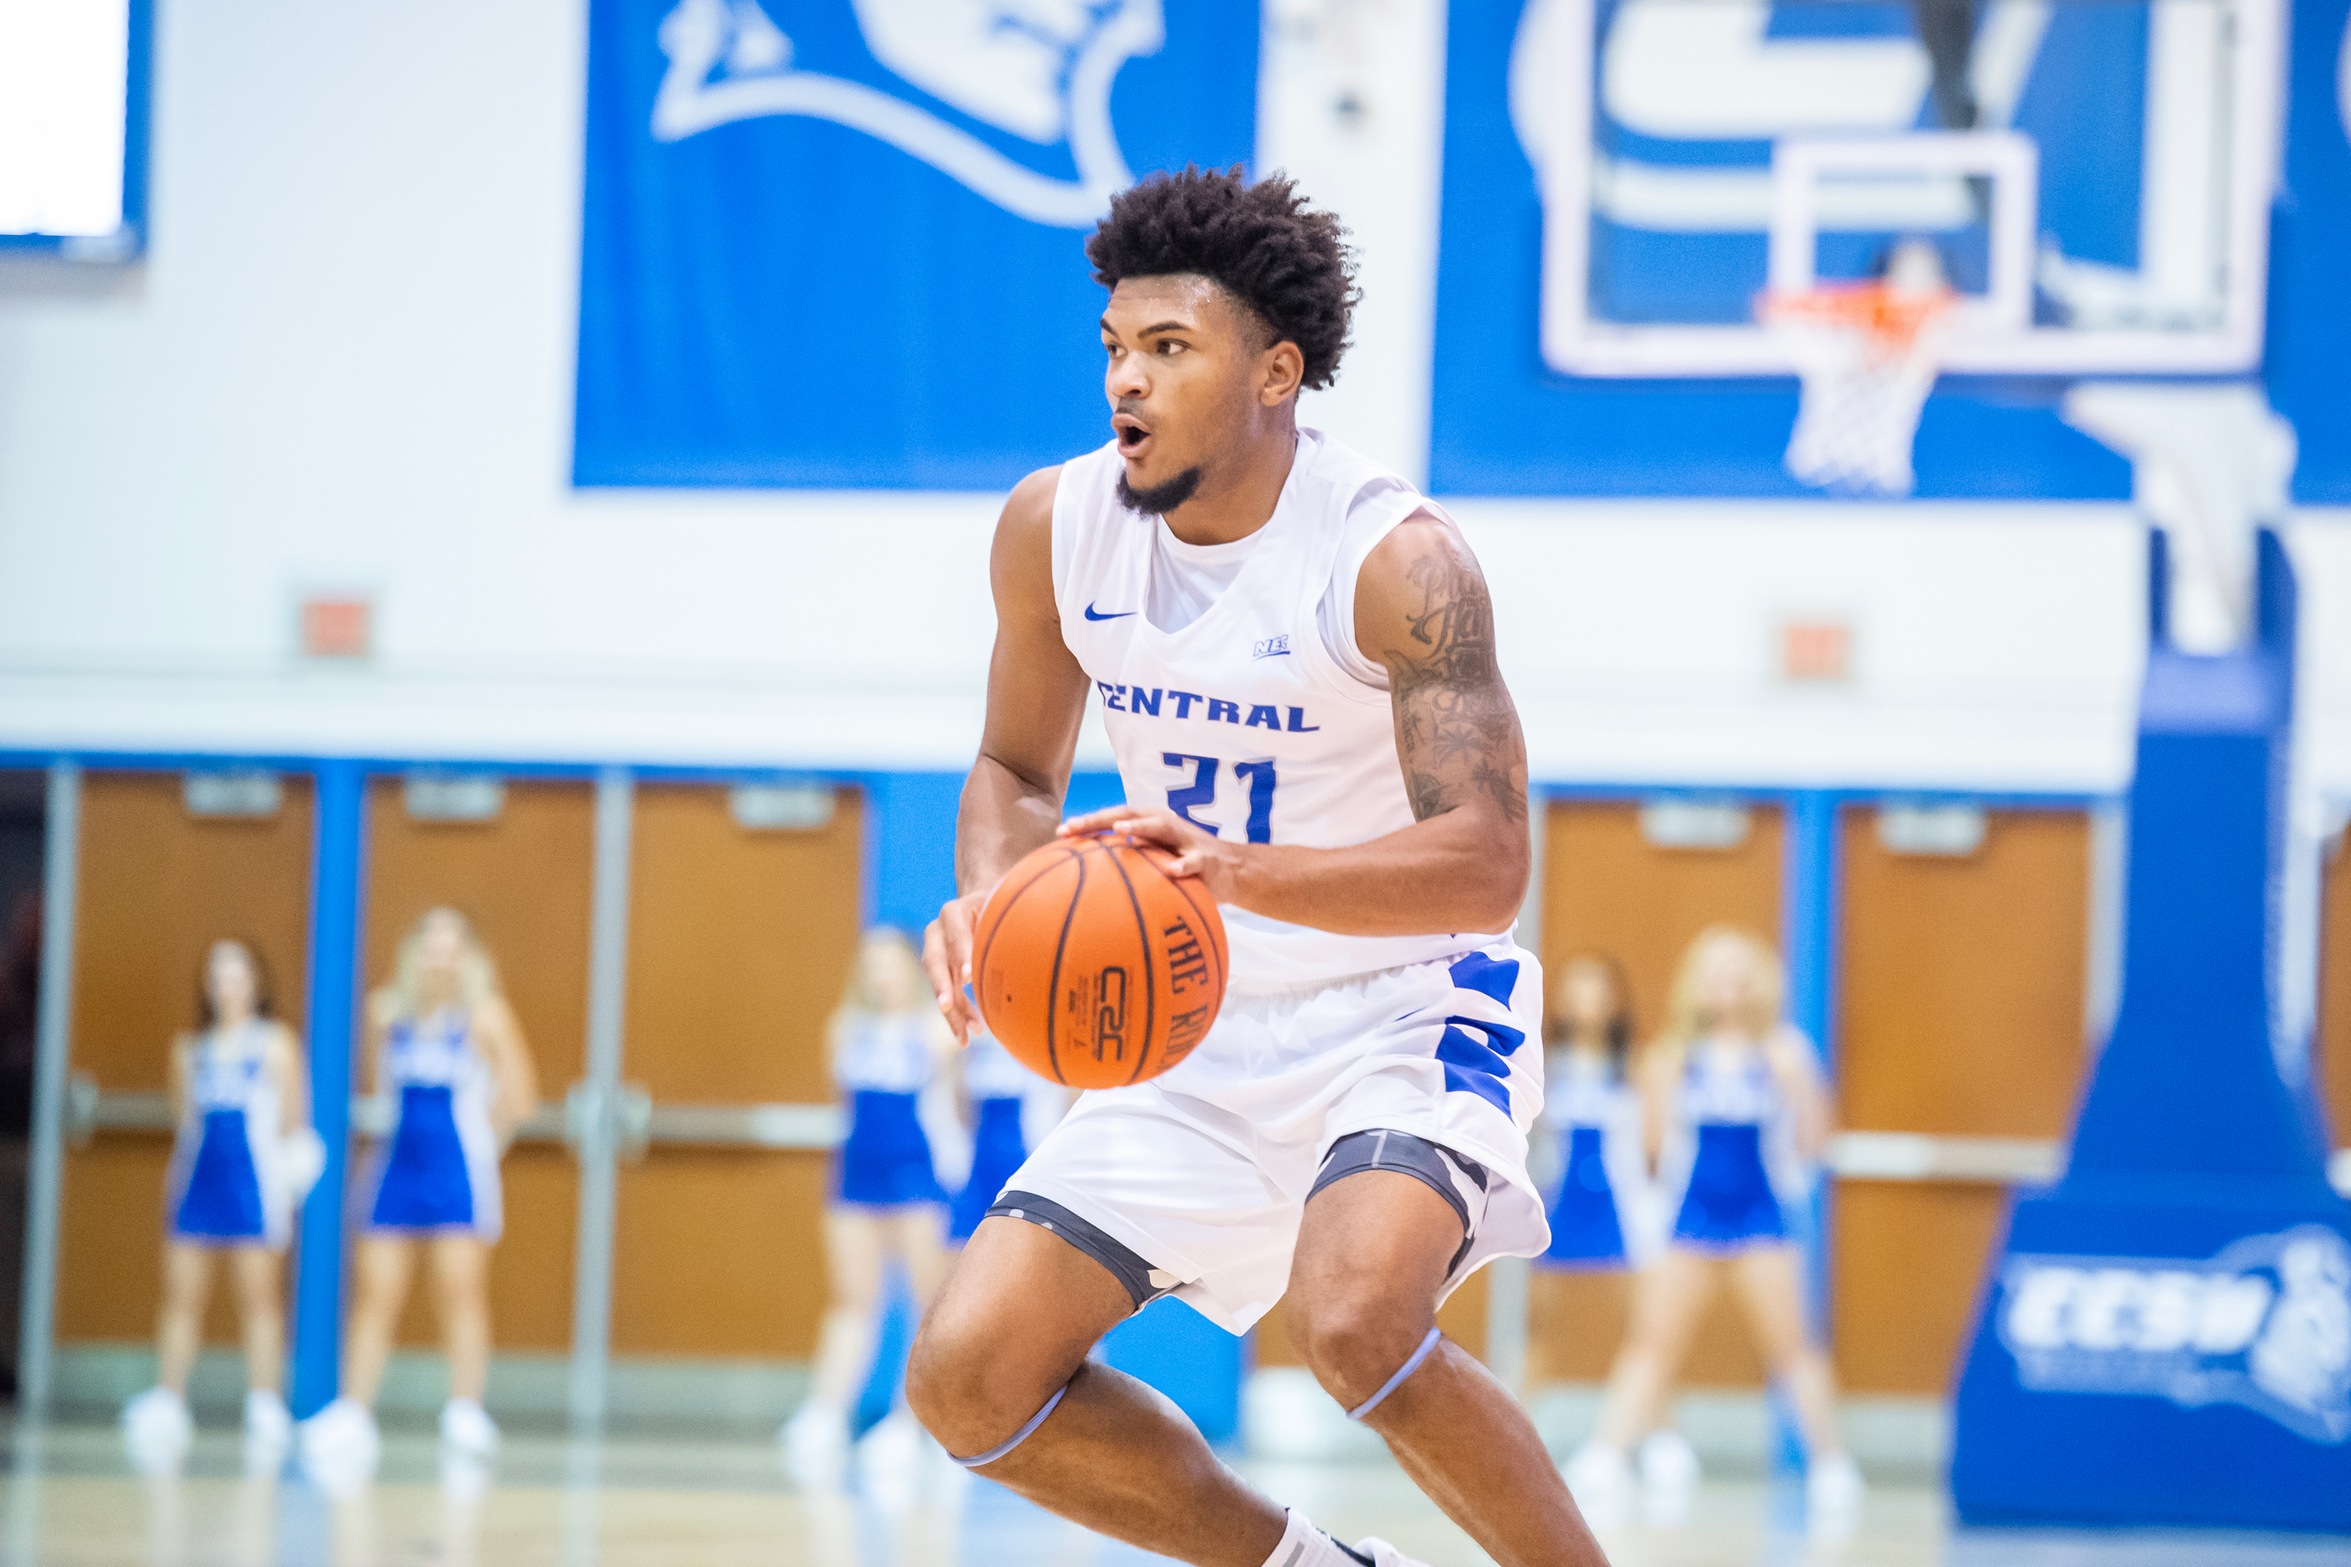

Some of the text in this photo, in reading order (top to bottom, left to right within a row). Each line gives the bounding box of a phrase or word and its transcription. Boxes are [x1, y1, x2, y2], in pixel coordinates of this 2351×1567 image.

[1160, 752, 1277, 845] 21
[1157, 915, 1209, 1074] THE ROC
